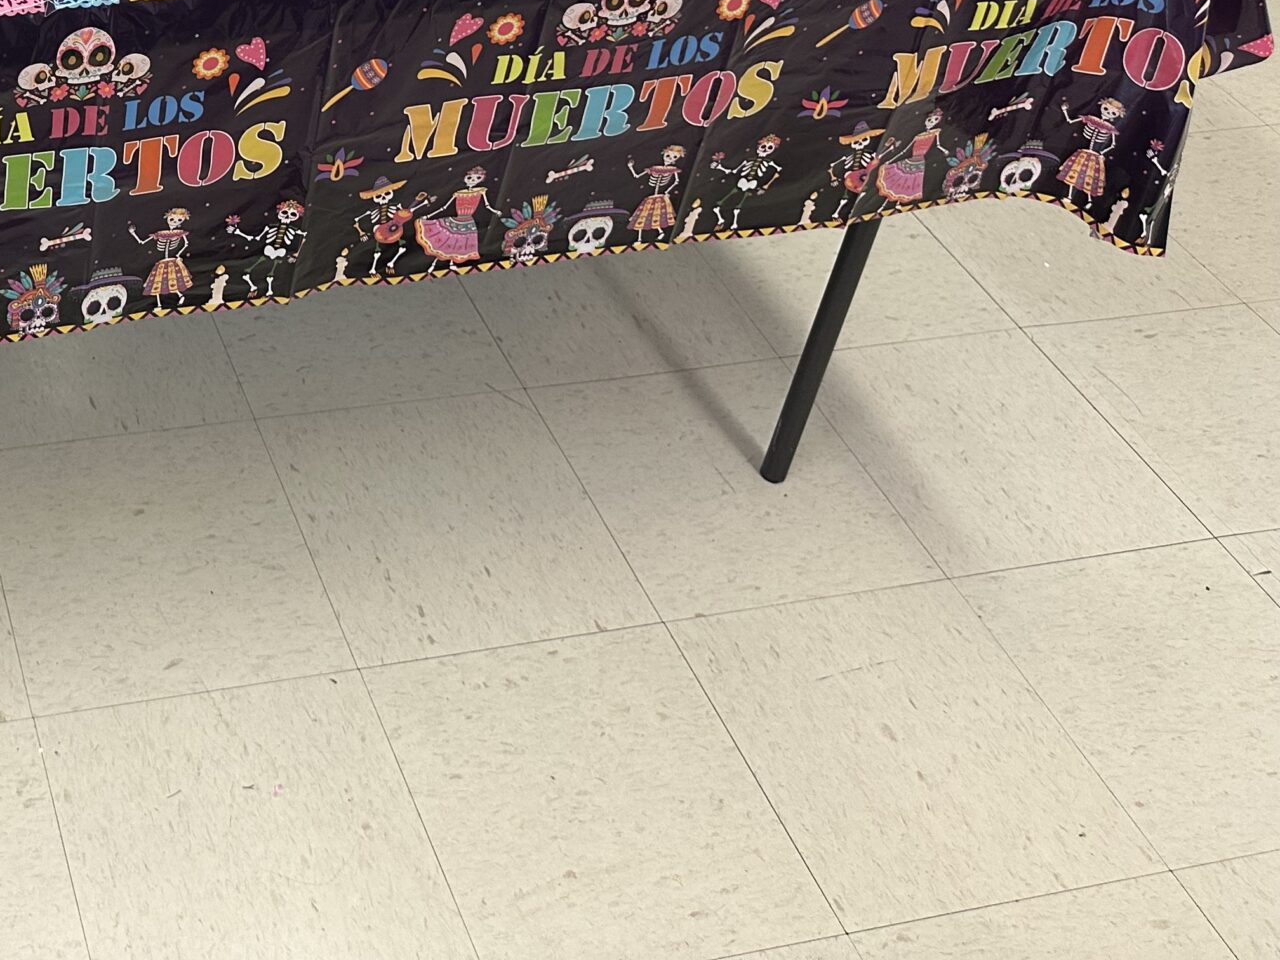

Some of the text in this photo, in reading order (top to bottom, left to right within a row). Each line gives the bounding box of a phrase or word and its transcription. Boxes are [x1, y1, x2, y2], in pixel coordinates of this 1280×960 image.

[490, 31, 725, 86] DÍA DE LOS
[49, 104, 111, 139] DE
[121, 90, 206, 132] LOS
[393, 60, 786, 163] MUERTOS
